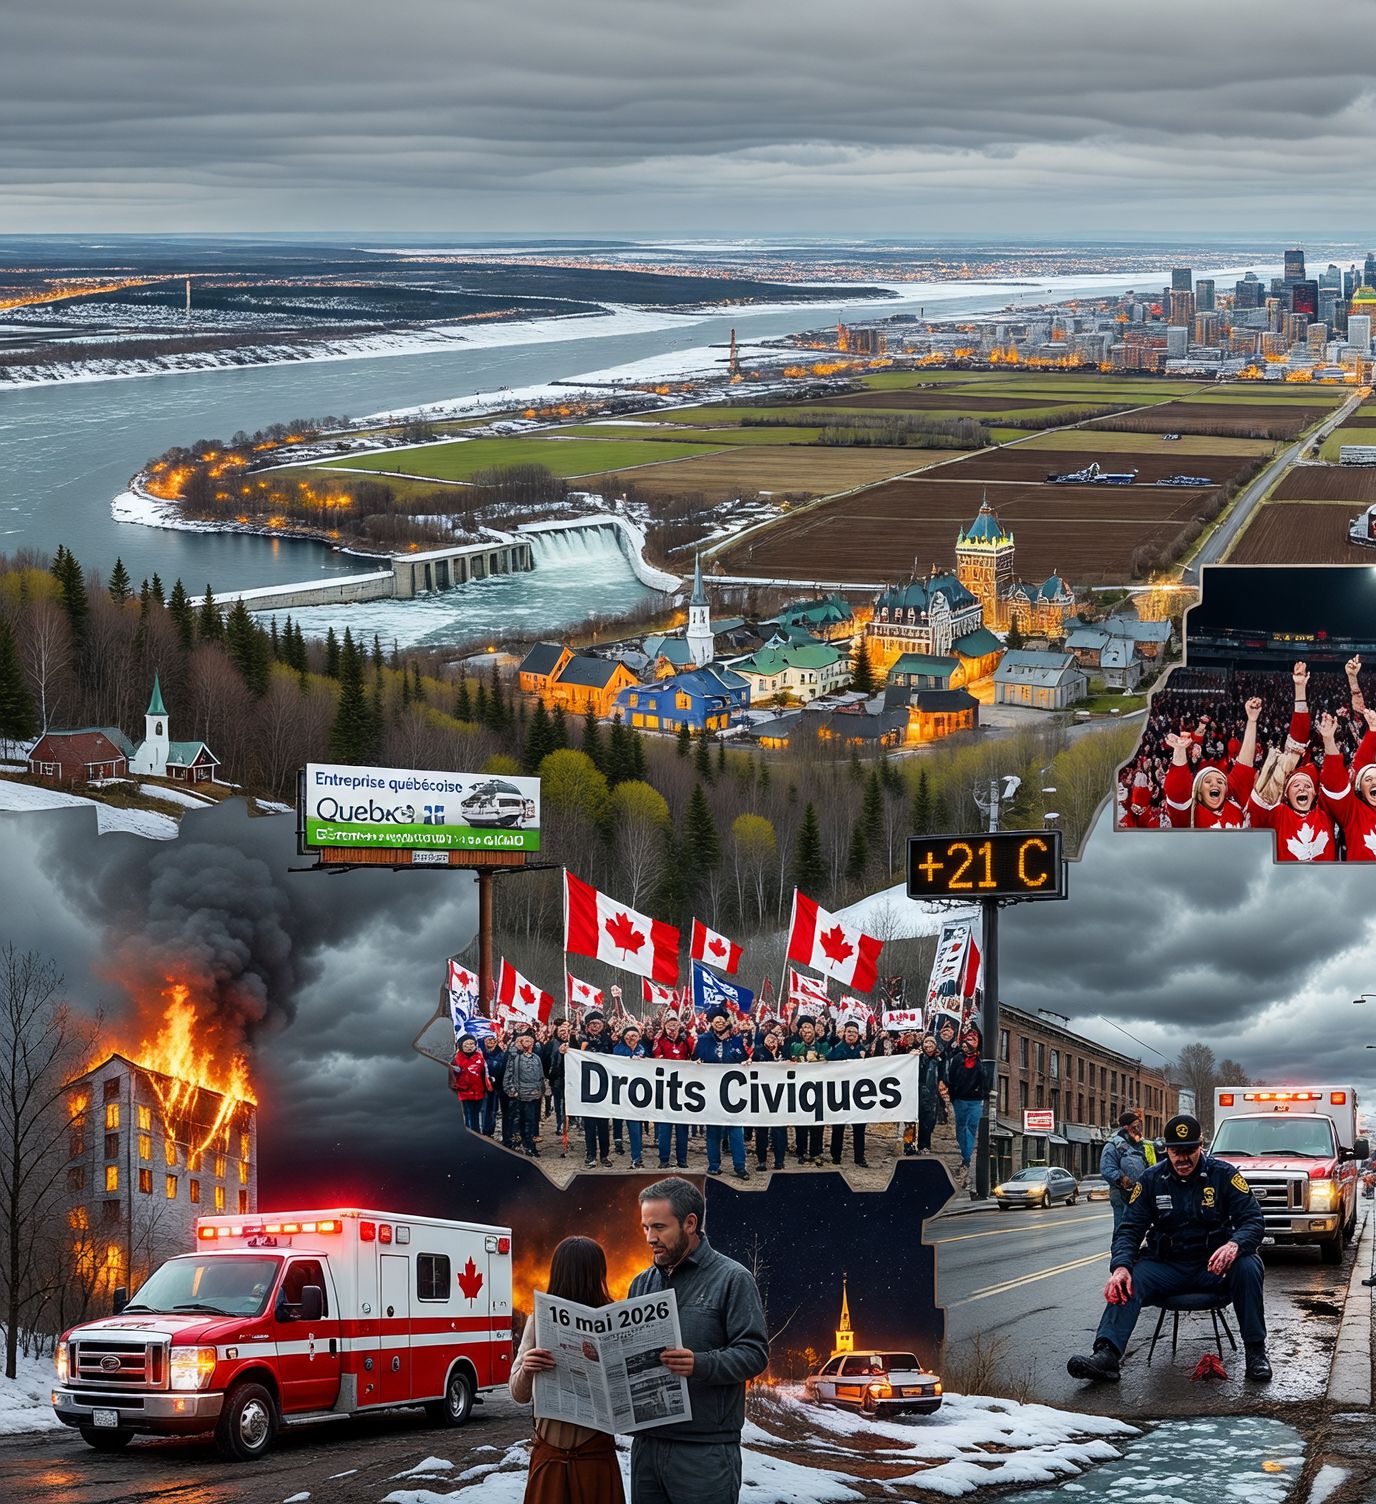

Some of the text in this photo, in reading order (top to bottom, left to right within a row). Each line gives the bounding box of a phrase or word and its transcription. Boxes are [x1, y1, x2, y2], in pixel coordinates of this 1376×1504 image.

[315, 771, 386, 790] Entreprise
[918, 838, 1048, 889] +21 C
[580, 1060, 902, 1122] Droits Civiques
[549, 1301, 670, 1334] 16 mai 2026
